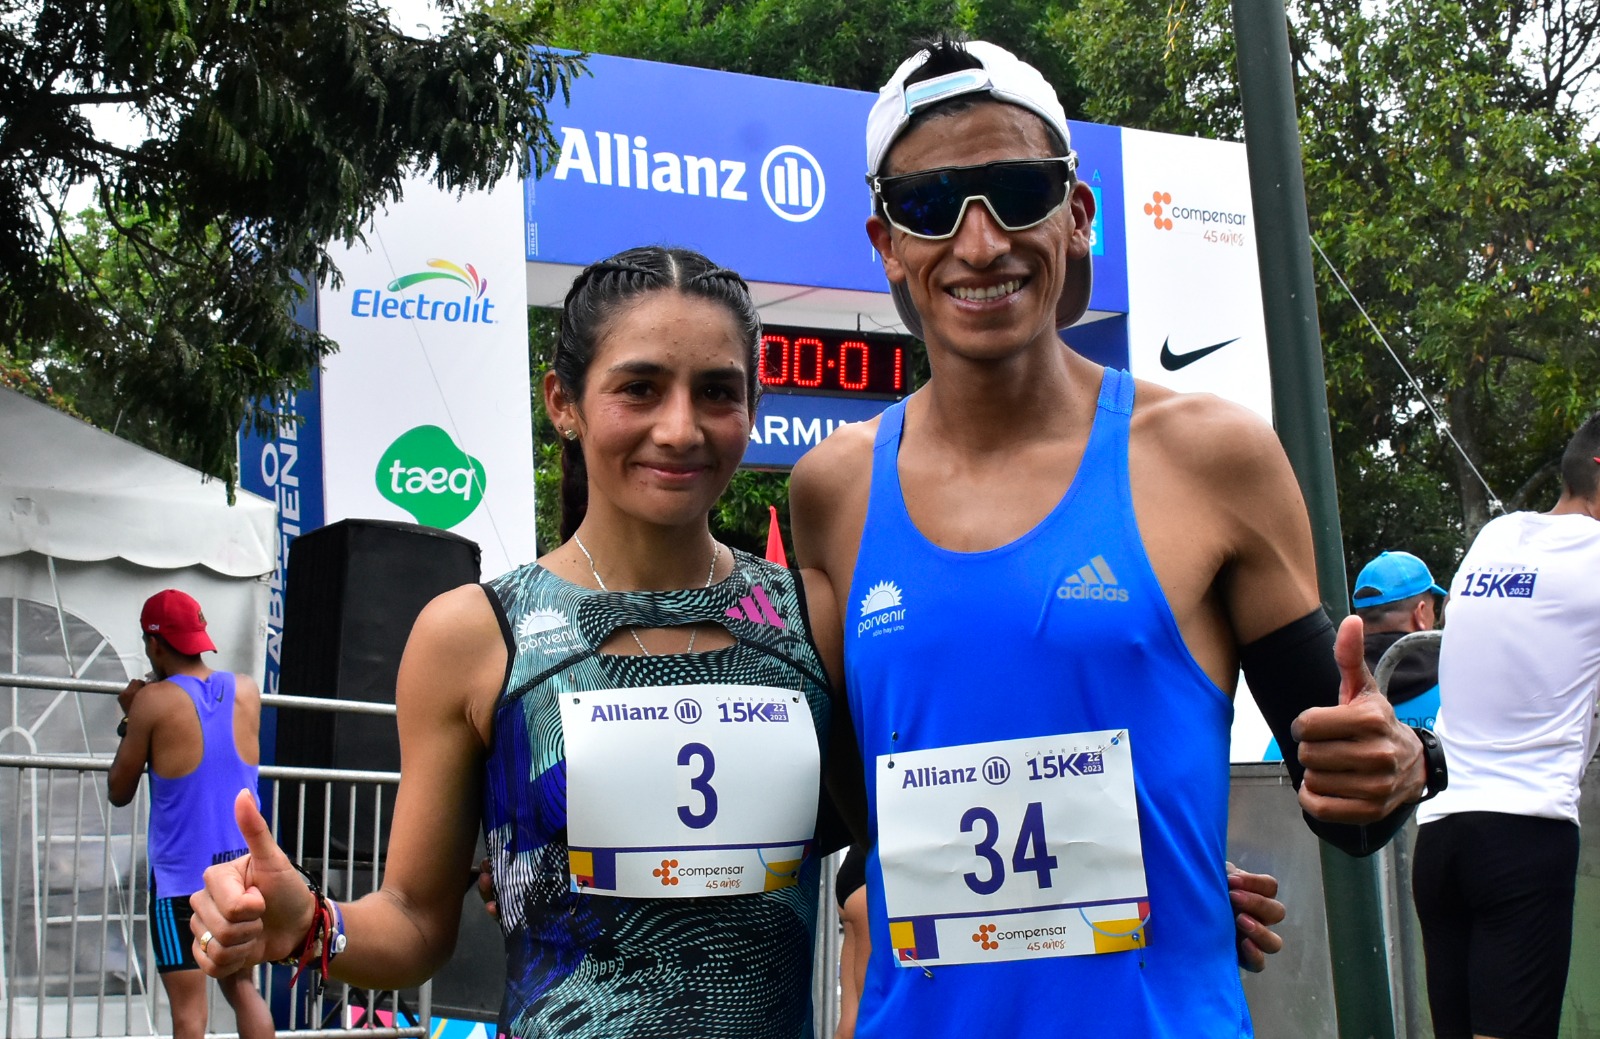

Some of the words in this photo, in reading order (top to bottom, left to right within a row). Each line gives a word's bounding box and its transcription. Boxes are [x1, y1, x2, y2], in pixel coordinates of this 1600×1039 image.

[553, 126, 748, 202] Allianz
[1172, 206, 1247, 226] compensar
[1203, 230, 1218, 243] 45
[351, 288, 495, 324] Electrolit
[389, 459, 476, 501] taeq
[1460, 572, 1513, 598] 15K
[1517, 574, 1533, 584] 22
[1056, 583, 1129, 603] adidas
[1508, 587, 1531, 596] 2023
[858, 608, 906, 638] porvenir
[518, 628, 580, 656] porvenir
[591, 704, 670, 722] Allianz
[717, 702, 768, 723] 15K
[773, 704, 785, 712] 22
[1086, 752, 1101, 762] 22
[902, 766, 977, 789] Allianz
[1026, 753, 1081, 781] 15K
[1082, 765, 1102, 773] 2023
[676, 742, 719, 830] 3
[959, 801, 1058, 896] 34
[678, 865, 744, 878] compensar
[705, 880, 719, 889] 45
[720, 877, 742, 889] años
[997, 926, 1067, 940] compensar
[1026, 941, 1041, 951] 45
[1042, 938, 1067, 950] años
